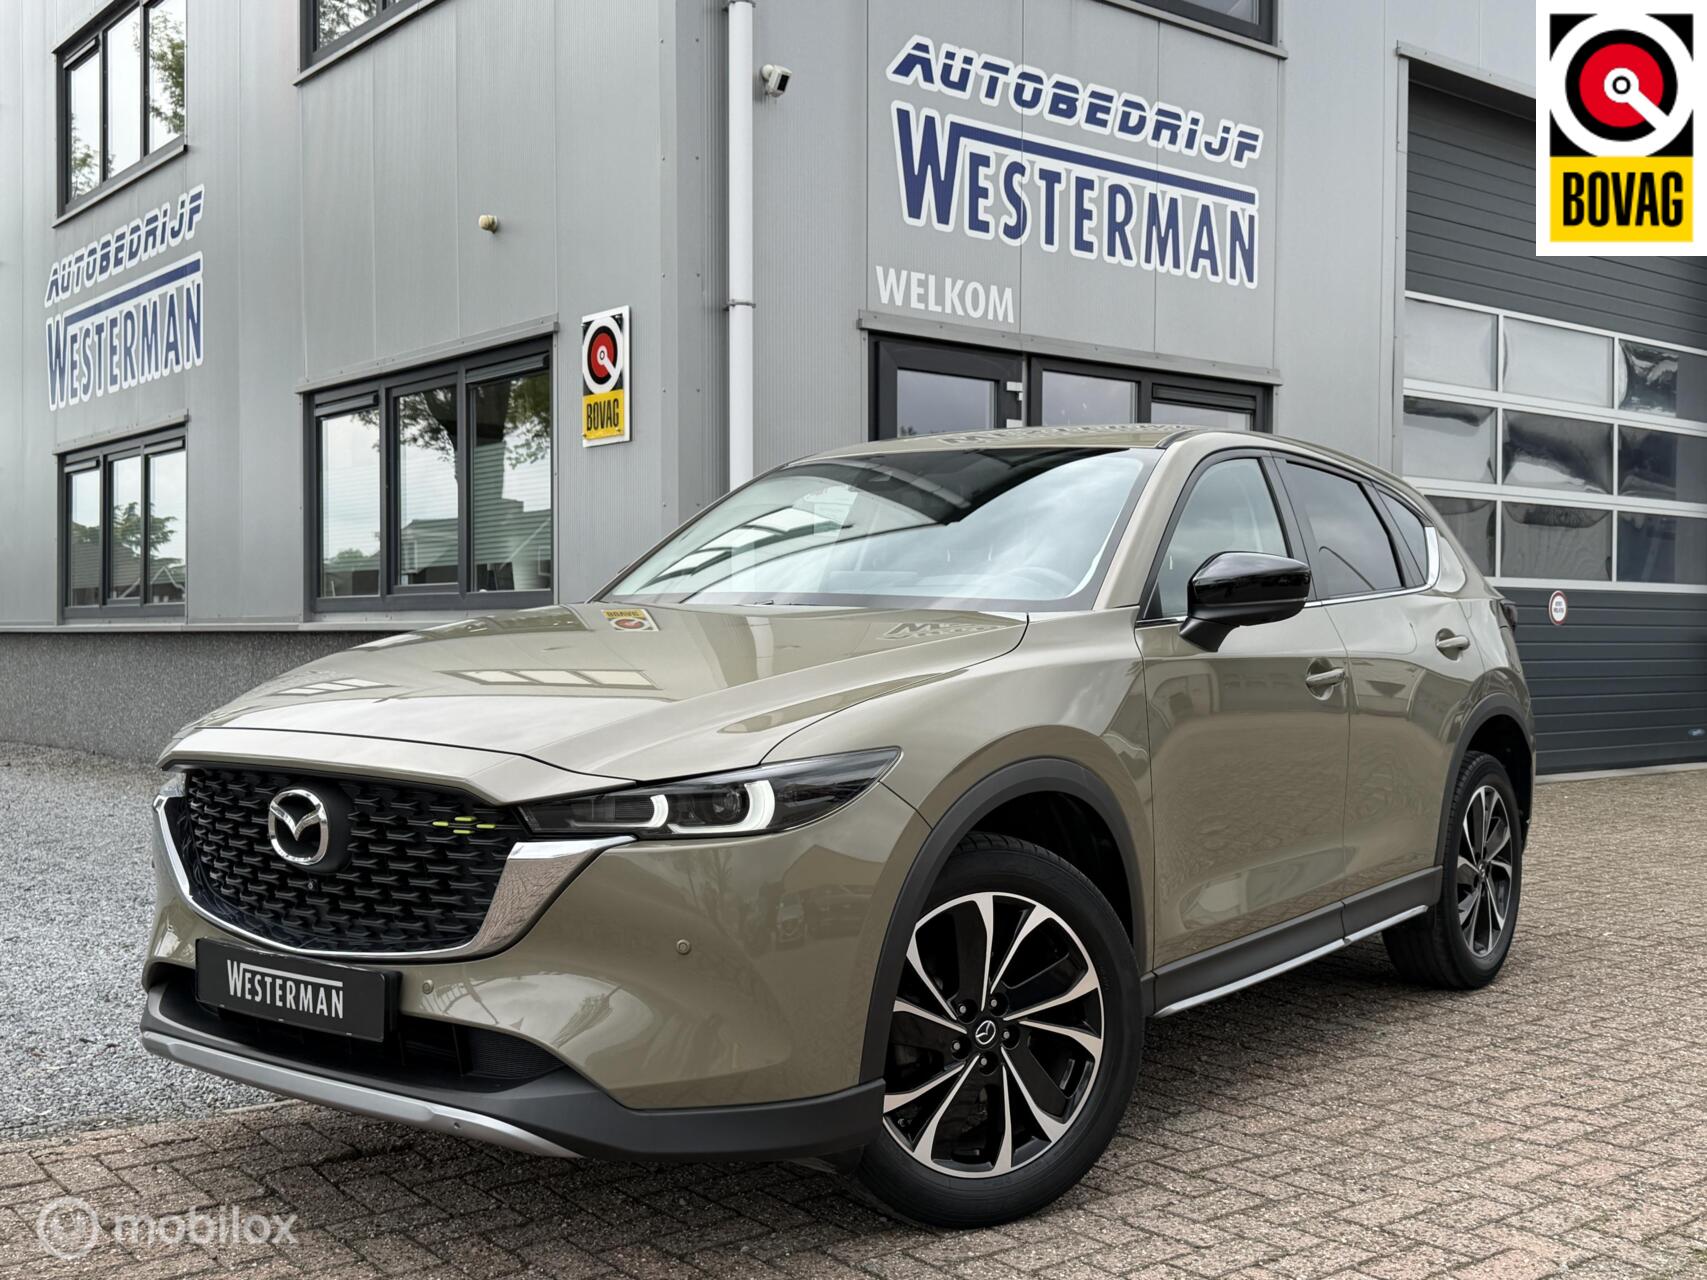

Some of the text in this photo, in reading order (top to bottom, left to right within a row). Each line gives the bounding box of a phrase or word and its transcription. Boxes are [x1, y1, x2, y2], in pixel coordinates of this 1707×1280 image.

[887, 35, 1263, 168] AUTOBEDRIJF
[45, 184, 204, 308] AUTOBEDRIJF
[891, 100, 1259, 289] WESTERMAN
[46, 254, 203, 411] WESTERMAN
[875, 264, 1015, 324] WELKOM
[586, 397, 620, 432] BOVAG
[226, 959, 344, 1020] WESTERMAN
